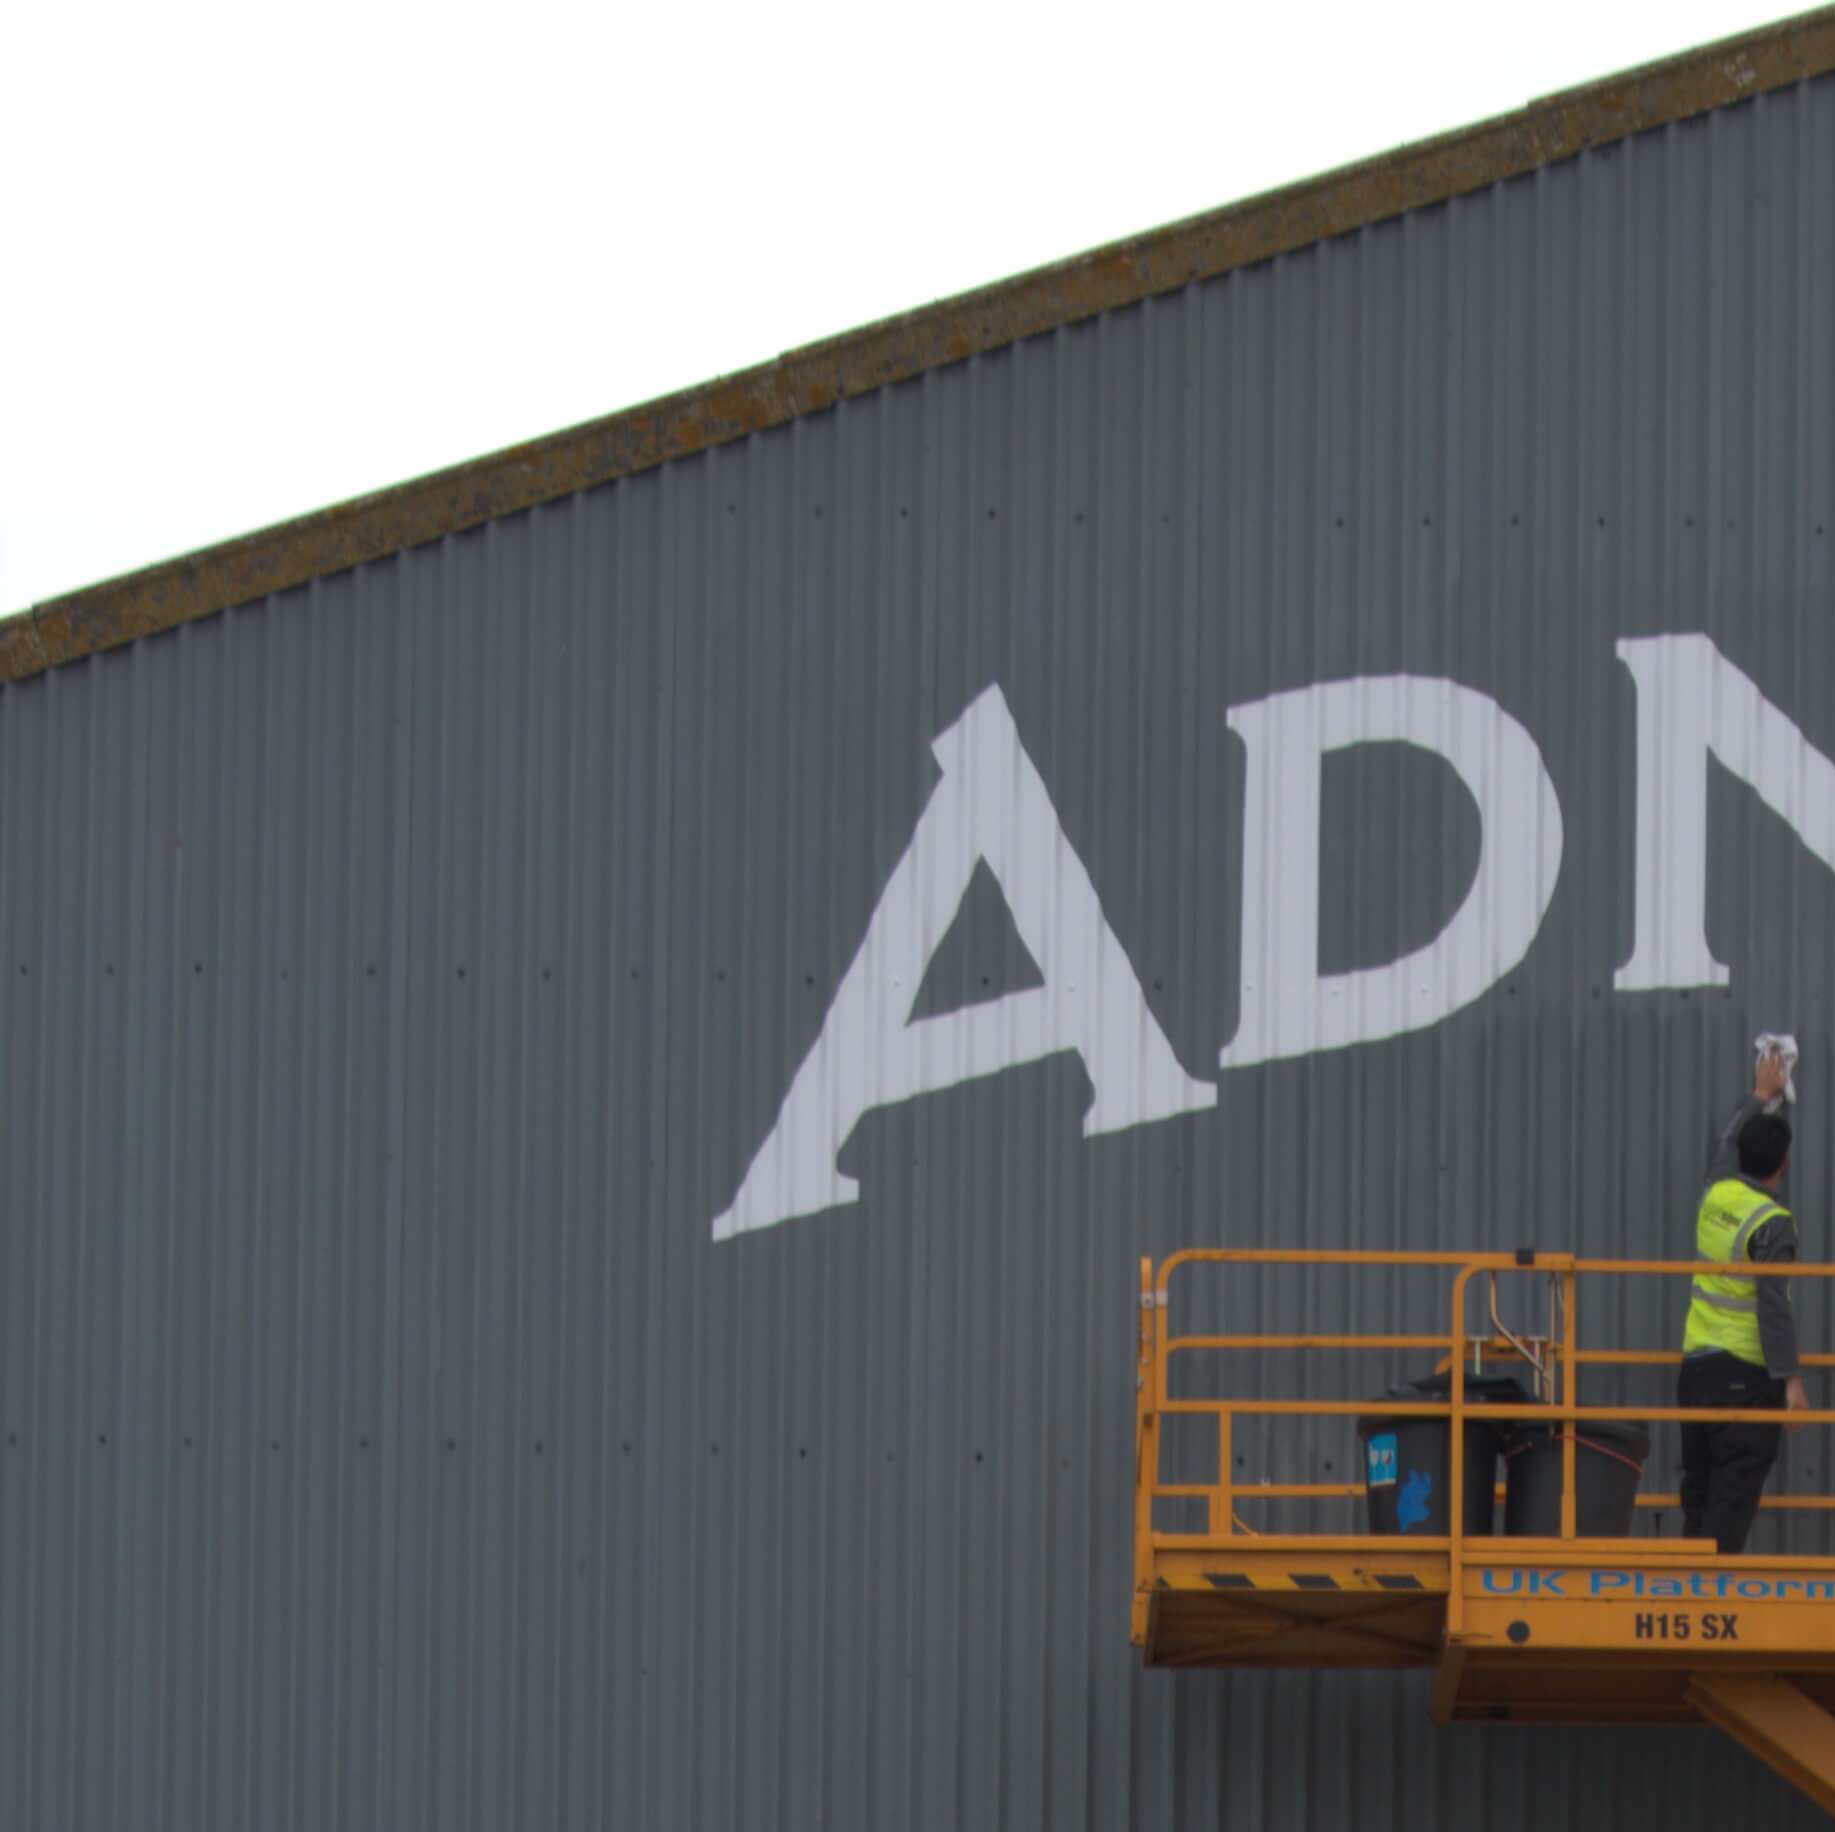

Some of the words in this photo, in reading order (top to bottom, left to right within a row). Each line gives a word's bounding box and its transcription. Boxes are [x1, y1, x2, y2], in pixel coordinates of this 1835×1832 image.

[1481, 1567, 1565, 1595] UK
[1635, 1613, 1691, 1640] H15
[1701, 1613, 1738, 1640] SX
